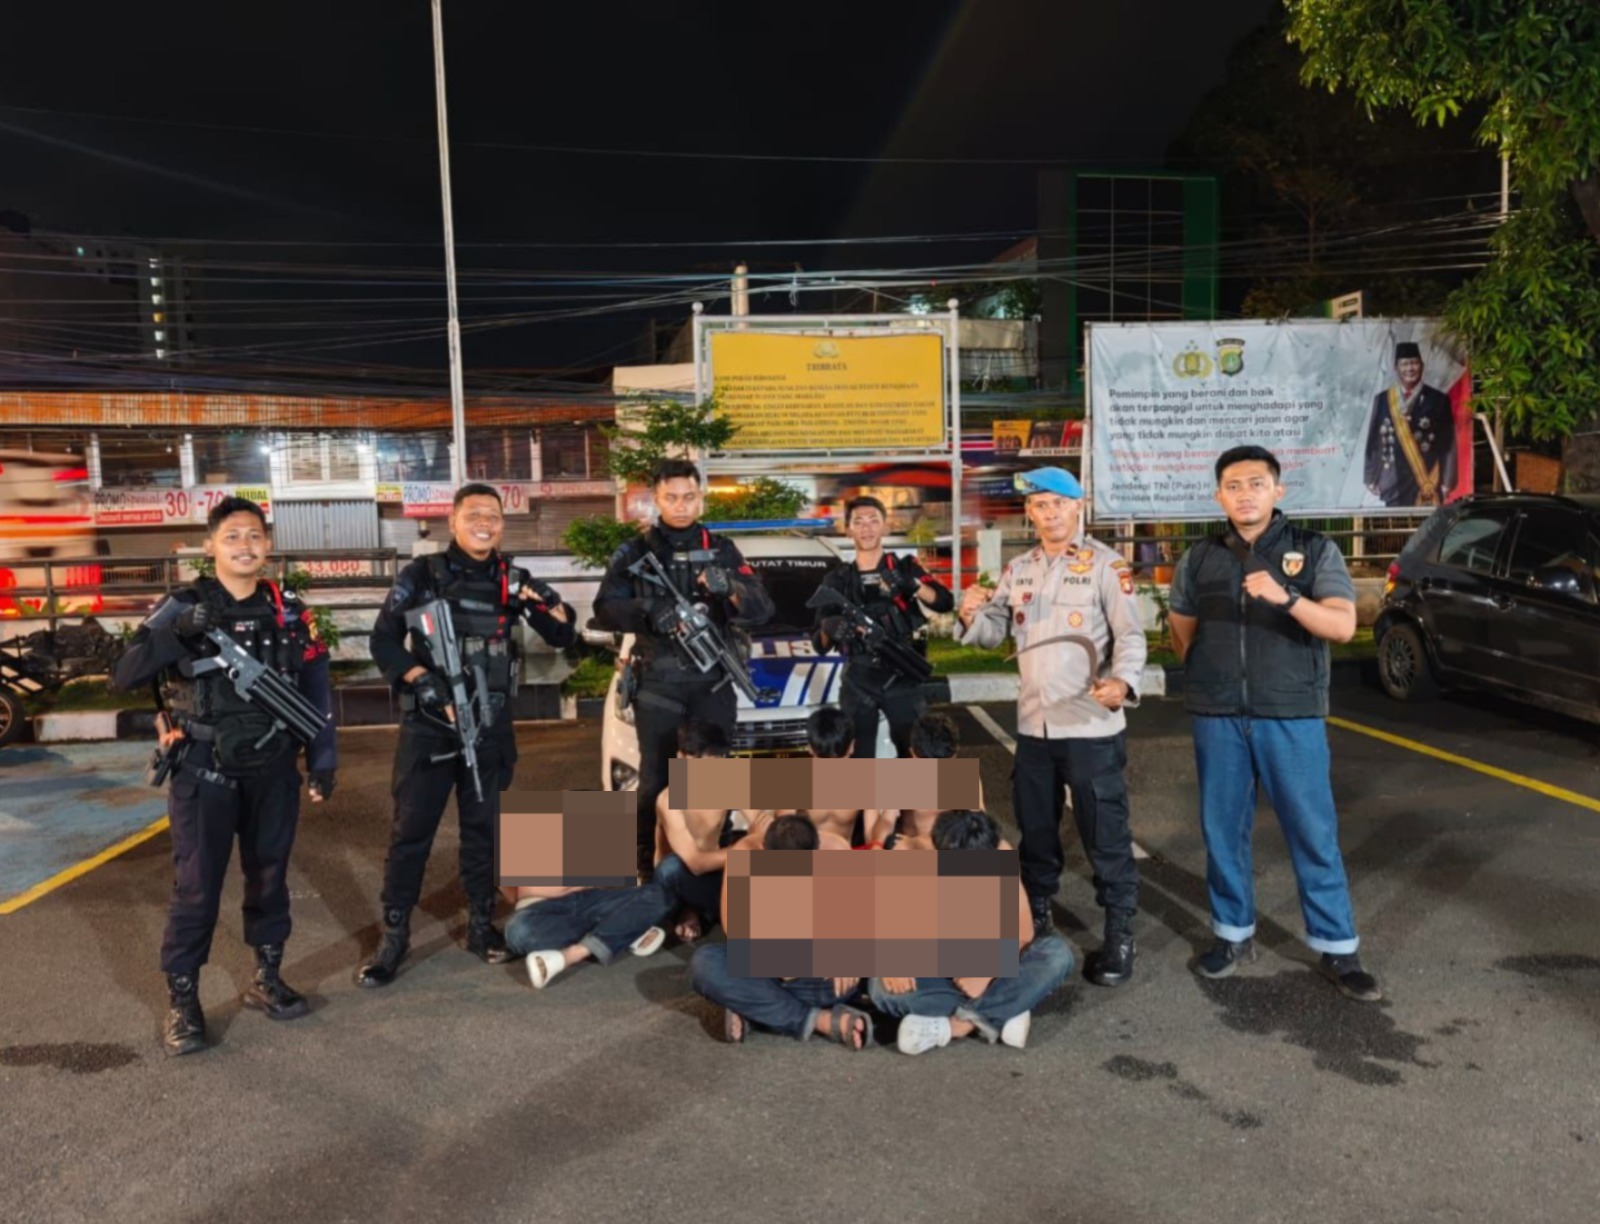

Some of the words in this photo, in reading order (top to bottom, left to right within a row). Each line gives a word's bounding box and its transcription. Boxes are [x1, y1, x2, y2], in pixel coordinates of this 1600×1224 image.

[1109, 389, 1160, 399] Pemimpin
[1162, 391, 1189, 399] yang
[1191, 389, 1226, 398] berani
[1228, 388, 1248, 397] dan
[1251, 387, 1274, 396] baik
[1109, 402, 1135, 412] akan
[1137, 402, 1193, 414] terpanggil
[1195, 401, 1224, 411] untuk
[1227, 401, 1295, 413] menghadapi
[1298, 401, 1324, 410] yang
[1110, 417, 1136, 426] tidak
[1139, 416, 1184, 427] mungkin
[1186, 416, 1207, 425] dan
[1209, 415, 1253, 425] mencari
[1254, 414, 1282, 425] jalan
[1284, 415, 1310, 424] agar
[1110, 431, 1136, 441] yang
[1138, 430, 1165, 439] tidak
[1167, 429, 1213, 441] mungkin
[1214, 429, 1248, 439] dapat
[1250, 428, 1271, 437] kita
[1157, 450, 1182, 459] yang
[1184, 448, 1218, 458] berani
[1286, 446, 1336, 455] membuat
[1153, 481, 1169, 490] TNI
[403, 486, 432, 503] PROMO
[501, 485, 521, 508] 70
[1153, 492, 1194, 502] Republik
[94, 492, 126, 510] PROMO
[747, 559, 783, 568] UTAT
[786, 559, 827, 568] TIMUR
[1063, 576, 1091, 585] POLRI
